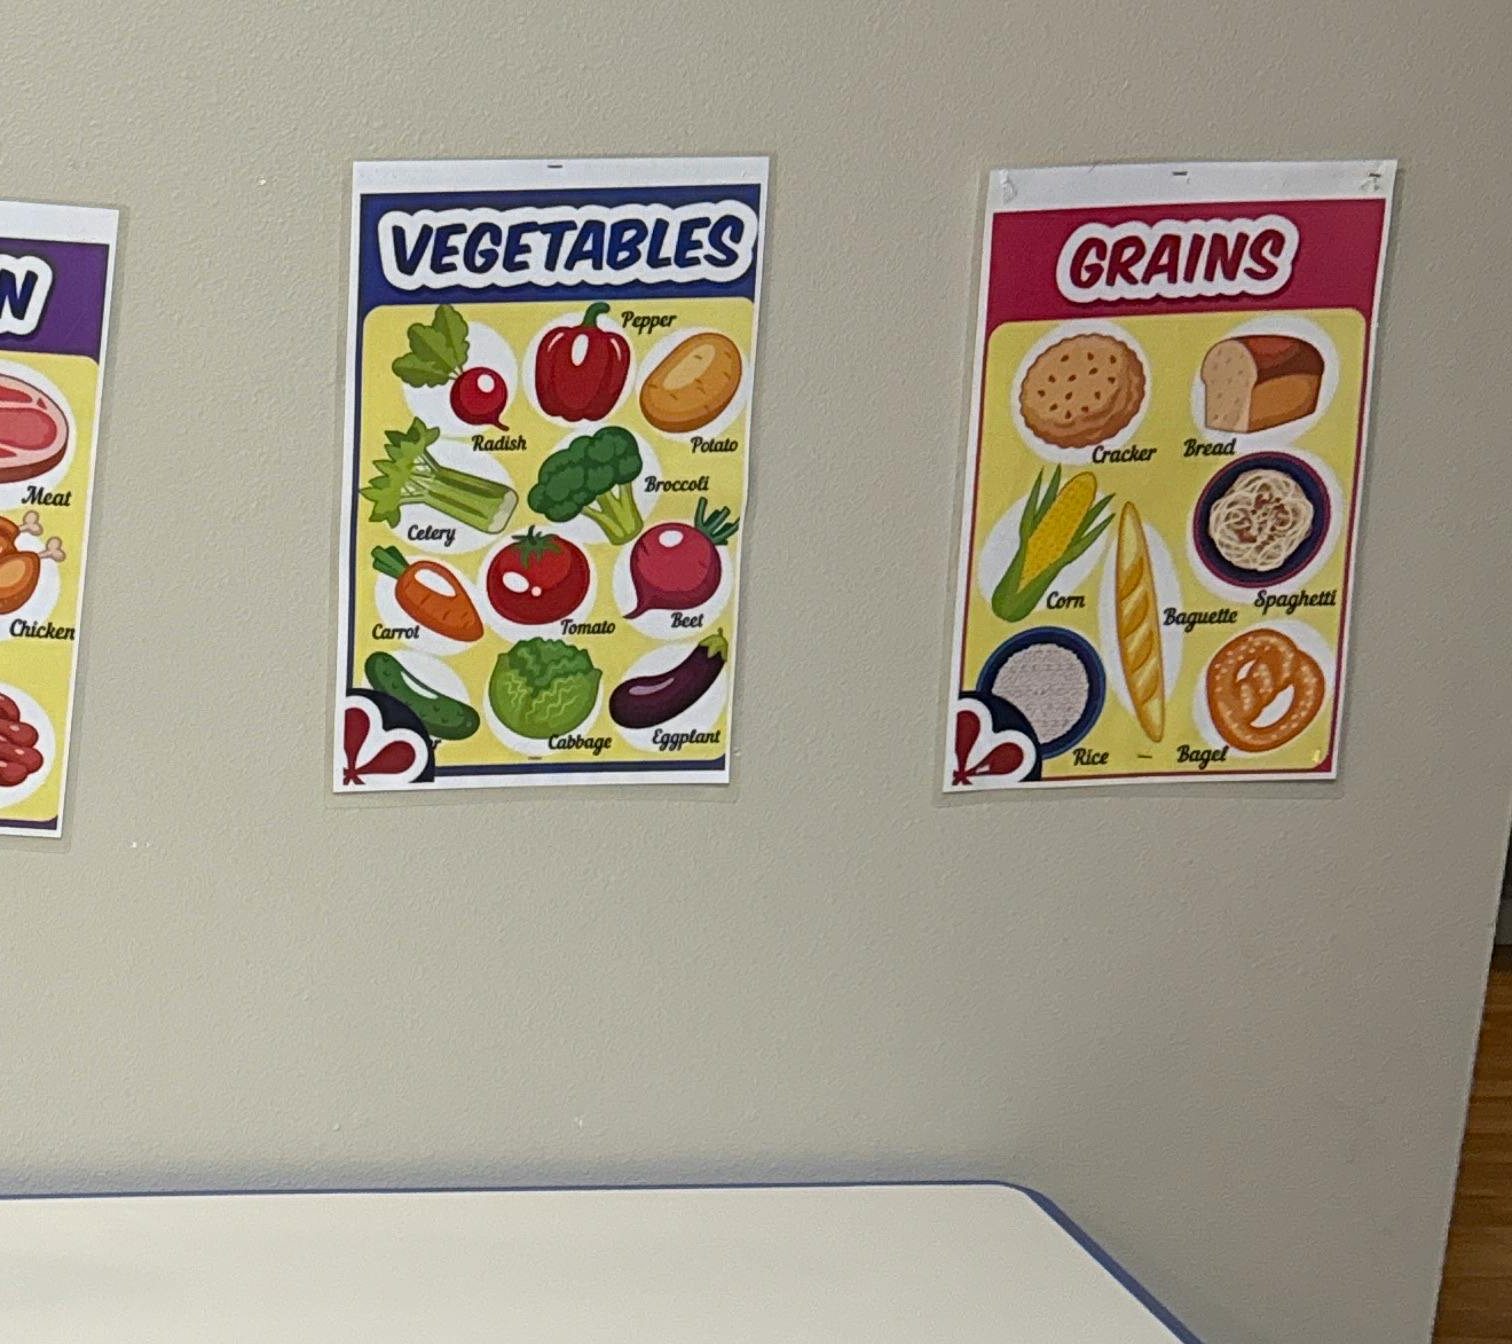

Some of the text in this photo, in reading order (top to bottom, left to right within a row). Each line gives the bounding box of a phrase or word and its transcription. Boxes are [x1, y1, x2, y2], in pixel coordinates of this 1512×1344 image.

[391, 217, 745, 272] VEGETABLES
[1069, 229, 1284, 285] GRAINS
[621, 311, 674, 332] Pepper
[472, 435, 525, 451] Radish
[691, 436, 736, 454] Potato
[1184, 439, 1233, 456] Bread
[1092, 445, 1155, 463] Cracker
[644, 476, 707, 492] Broccoli
[22, 486, 70, 506] Meat
[407, 525, 454, 545] Celery
[1046, 592, 1083, 608] Corn
[1254, 589, 1335, 610] Spaghetti
[560, 618, 614, 634] Tomato
[670, 613, 702, 629] Beet
[1163, 606, 1236, 627] Baguette
[9, 620, 74, 639] Chicken
[371, 623, 418, 640] Carrot
[548, 733, 610, 752] Cabbage
[652, 728, 719, 747] Eggplant
[1073, 748, 1107, 765] Rice
[1177, 745, 1225, 767] Bagel
